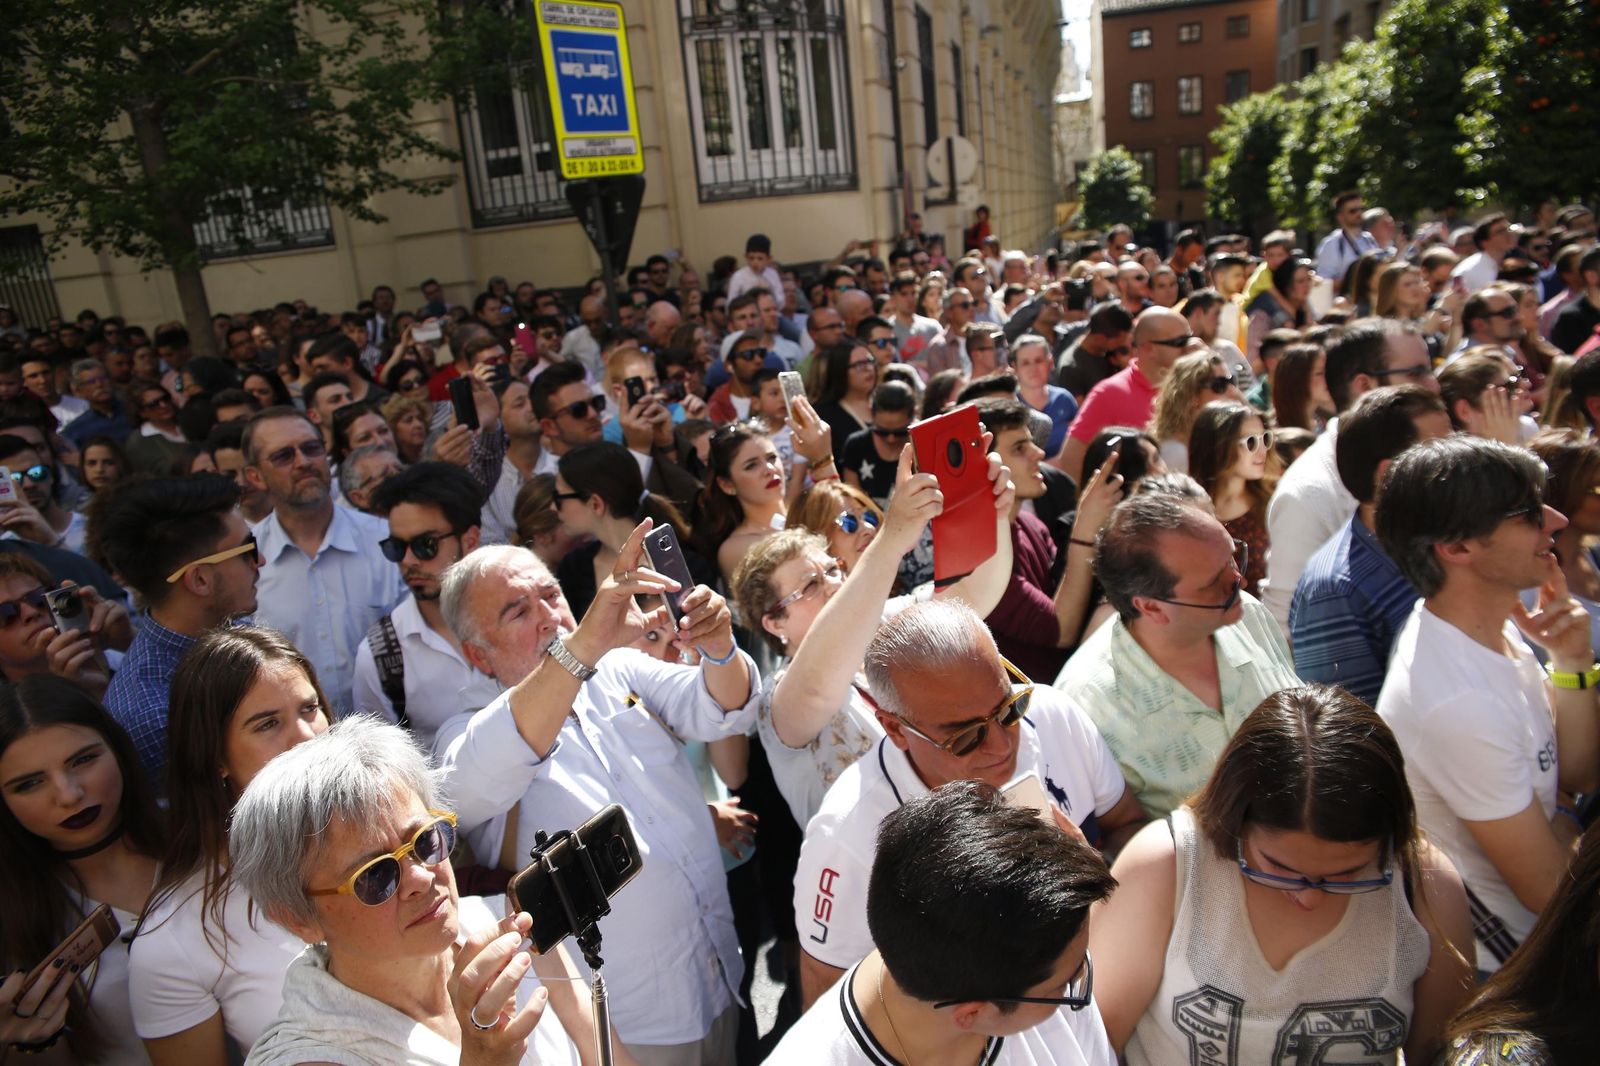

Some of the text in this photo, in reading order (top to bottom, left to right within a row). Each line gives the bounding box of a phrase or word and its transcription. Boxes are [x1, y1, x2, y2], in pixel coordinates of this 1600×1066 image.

[571, 93, 618, 116] TAXI
[566, 161, 578, 174] DE
[810, 868, 840, 944] USA
